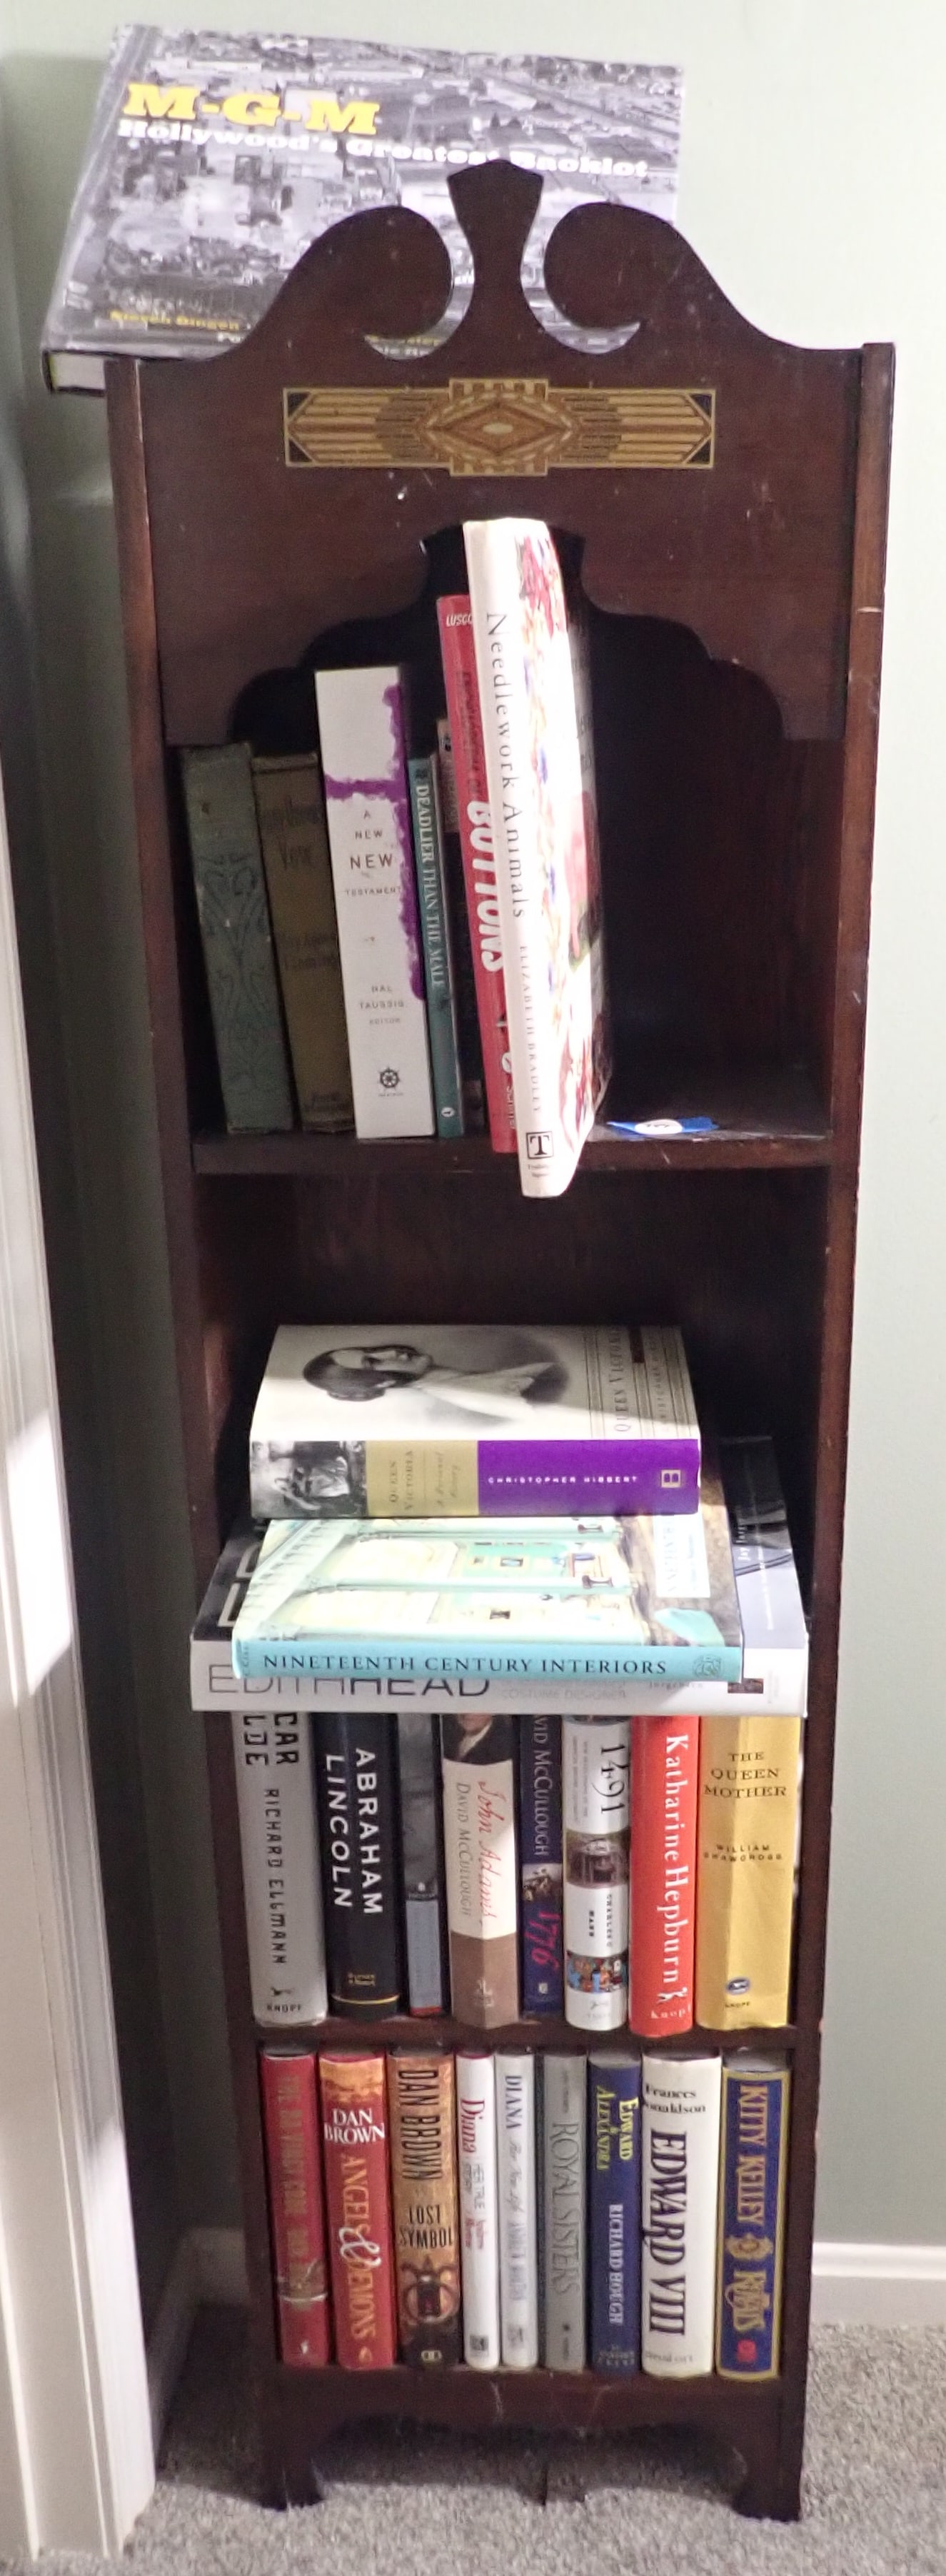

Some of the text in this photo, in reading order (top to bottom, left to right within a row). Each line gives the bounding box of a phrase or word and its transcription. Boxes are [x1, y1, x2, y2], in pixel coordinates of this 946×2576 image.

[123, 82, 381, 135] M-G-M
[117, 119, 338, 152] Hollywood's
[509, 150, 648, 178] Backlot
[486, 612, 530, 918] Needlework Animals
[355, 830, 383, 840] NEW
[363, 809, 371, 818] A
[415, 785, 436, 863] DEADLIER
[350, 854, 393, 870] NEW
[422, 865, 441, 910] THAN
[346, 885, 401, 897] TESTAMENT
[426, 914, 442, 941] THE
[371, 985, 393, 994] HAL
[428, 945, 446, 990] MALE
[520, 945, 540, 1112] ELIZABETH BRADLEY
[529, 1134, 550, 1156] T
[488, 1475, 638, 1484] CHRISTOPHER HIBBERT
[263, 1654, 414, 1670] NINETEENTH
[424, 1657, 533, 1673] CENTURY
[541, 1659, 667, 1675] INTERIORS
[243, 1714, 269, 1766] LDE
[274, 1713, 299, 1765] CAR
[533, 1714, 549, 1744] VID
[591, 1744, 630, 1814] 1491
[710, 1768, 780, 1781] QUEEN
[728, 1751, 765, 1762] THE
[456, 1783, 470, 1823] DAVID
[703, 1785, 787, 1799] MOTHER
[325, 1754, 353, 1907] LINCOLN
[356, 1747, 384, 1914] ABRAHAM
[476, 1781, 506, 1925] John Adams
[703, 1851, 783, 1862] SHAWCROSS
[715, 1843, 770, 1853] WILLIAM
[264, 1788, 287, 1964] RICHARD ELLMANN
[656, 1734, 690, 1983] Katharine Hepburn
[525, 1911, 561, 1970] 1776
[332, 2107, 373, 2127] DAN
[505, 2075, 523, 2130] DIANA
[645, 2083, 697, 2099] Frances
[323, 2123, 386, 2145] BROWN
[398, 2070, 443, 2181] DAN BROWN
[461, 2098, 485, 2154] Diana
[619, 2095, 640, 2161] EDWARD
[735, 2084, 769, 2226] KITTY KELLEY
[341, 2153, 371, 2234] ANGELS
[408, 2204, 441, 2224] LOST
[549, 2122, 580, 2295] ROYAL SISTERS
[643, 2128, 688, 2265] EDWARD
[400, 2227, 453, 2249] SYMBOL
[608, 2203, 624, 2325] RICHARD HOUGH
[649, 2274, 686, 2336] VIII
